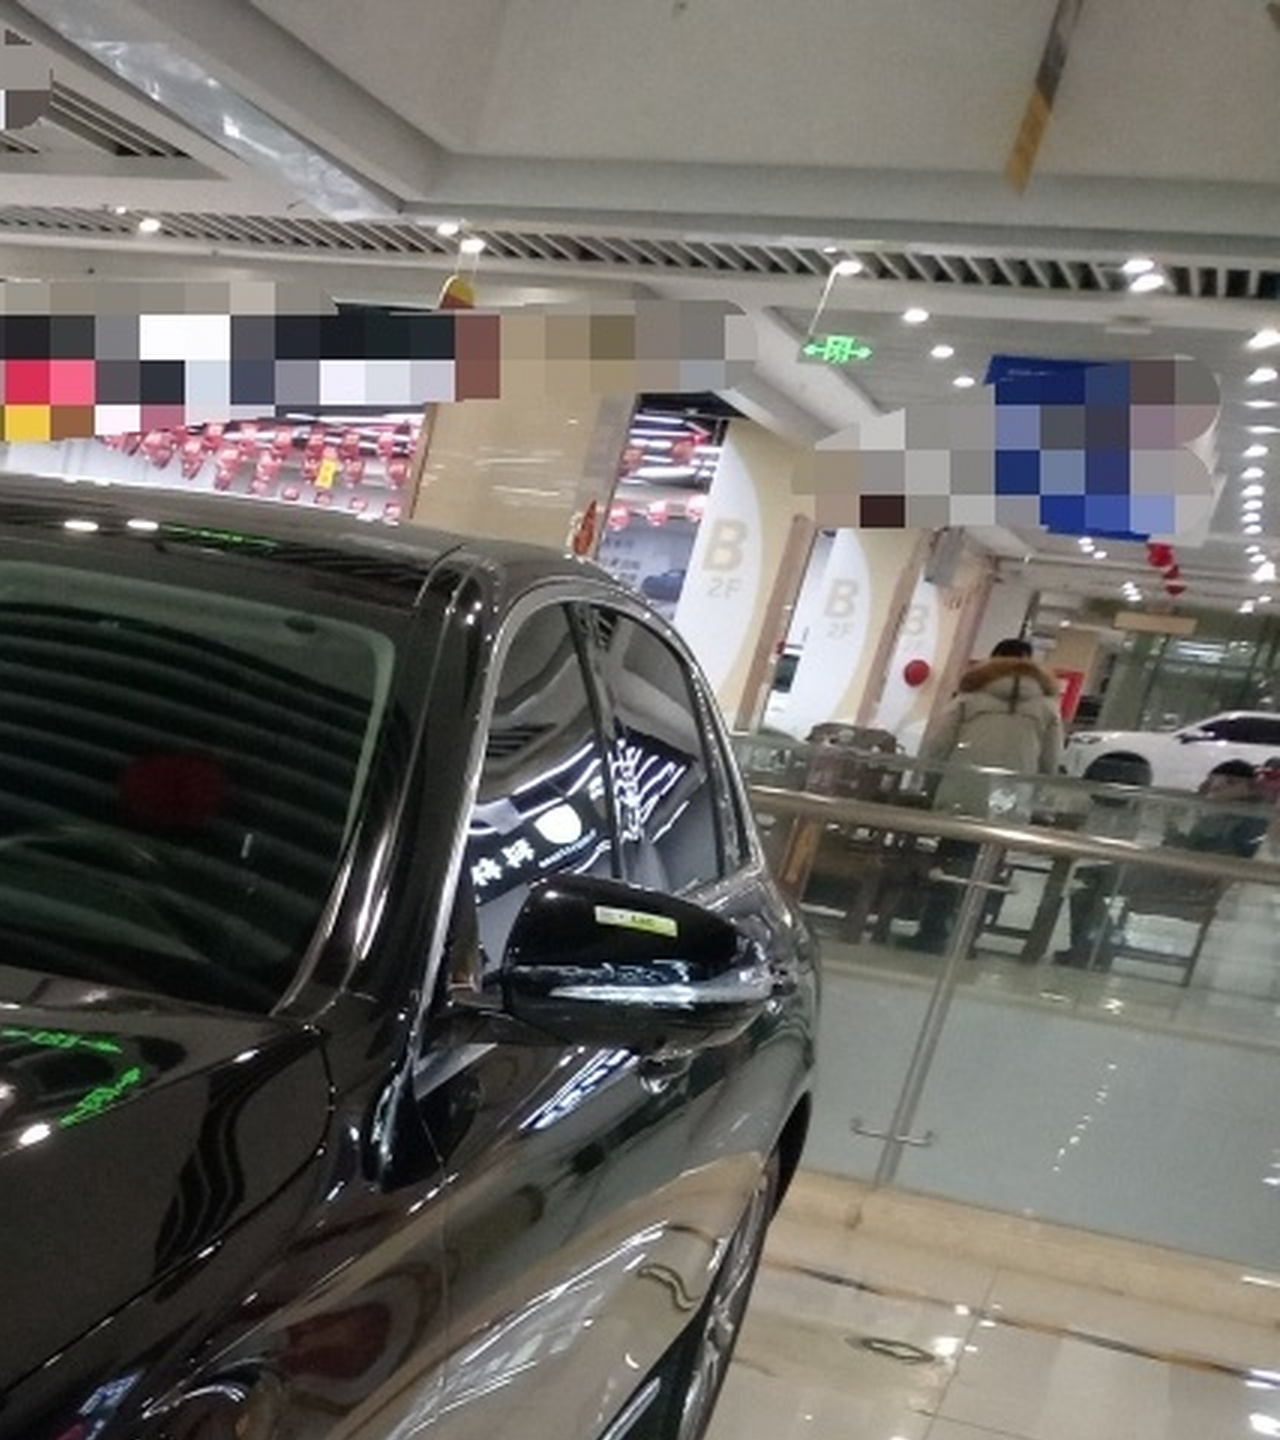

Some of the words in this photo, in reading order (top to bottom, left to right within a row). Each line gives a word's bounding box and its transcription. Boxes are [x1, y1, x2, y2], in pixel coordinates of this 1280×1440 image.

[702, 518, 749, 572] B
[707, 577, 741, 600] 2F
[824, 579, 859, 618] B
